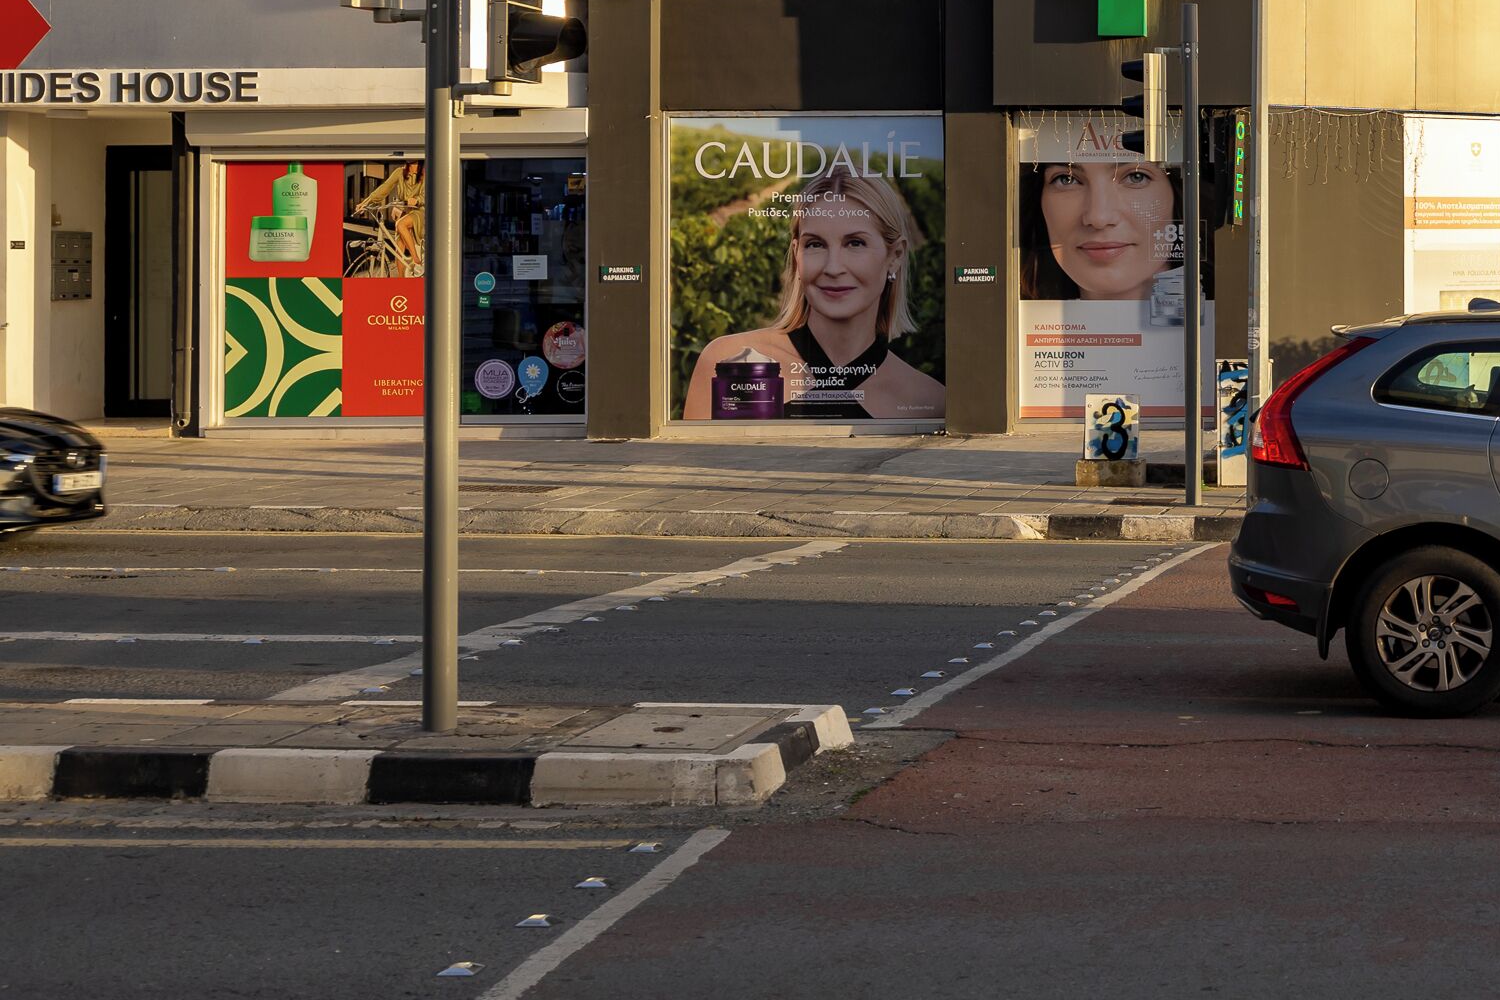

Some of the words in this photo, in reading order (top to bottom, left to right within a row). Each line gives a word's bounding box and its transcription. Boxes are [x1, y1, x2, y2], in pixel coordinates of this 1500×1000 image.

[0, 72, 101, 103] IDES
[112, 72, 259, 103] HOUSE
[1235, 121, 1246, 219] OPEN
[771, 191, 820, 204] Premier
[823, 191, 846, 204] Cru
[748, 207, 790, 218] Ρυτίδες,
[792, 207, 835, 219] κηλίδες,
[838, 208, 870, 219] όγκος
[608, 266, 634, 274] PARKING
[1034, 351, 1085, 359] HYALURON
[811, 366, 827, 374] πιο
[828, 364, 877, 375] σφριγηλή
[1034, 360, 1060, 368] ACTIV
[1062, 360, 1074, 368] B3
[791, 391, 820, 399] Πατέντα
[1101, 402, 1129, 462] 3
